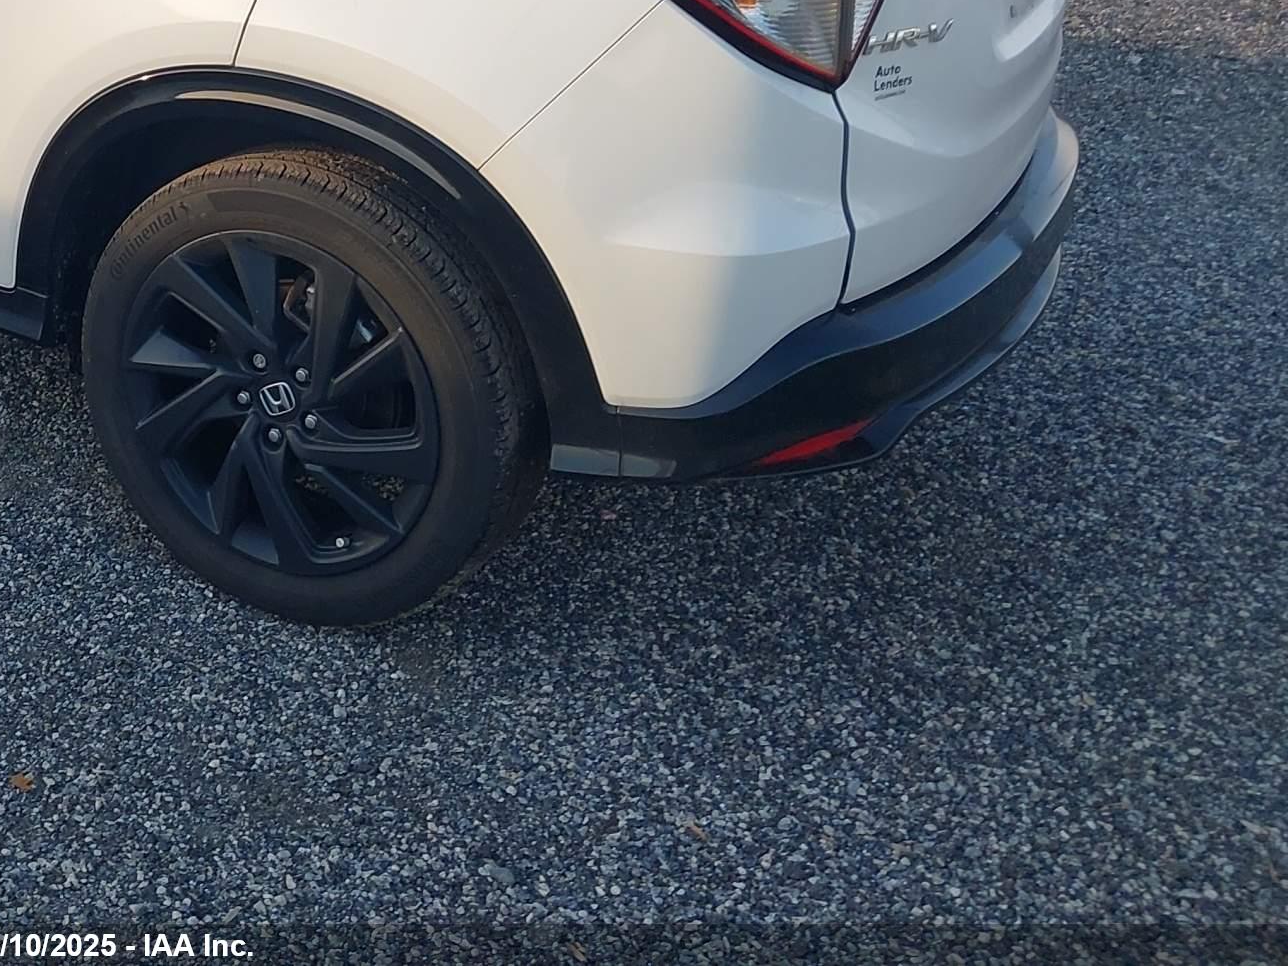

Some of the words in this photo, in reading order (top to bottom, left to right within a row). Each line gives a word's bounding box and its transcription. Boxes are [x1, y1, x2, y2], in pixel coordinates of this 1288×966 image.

[862, 18, 955, 56] HR-V
[873, 75, 913, 92] Lenders
[875, 65, 902, 79] Auto
[111, 205, 178, 280] Continental
